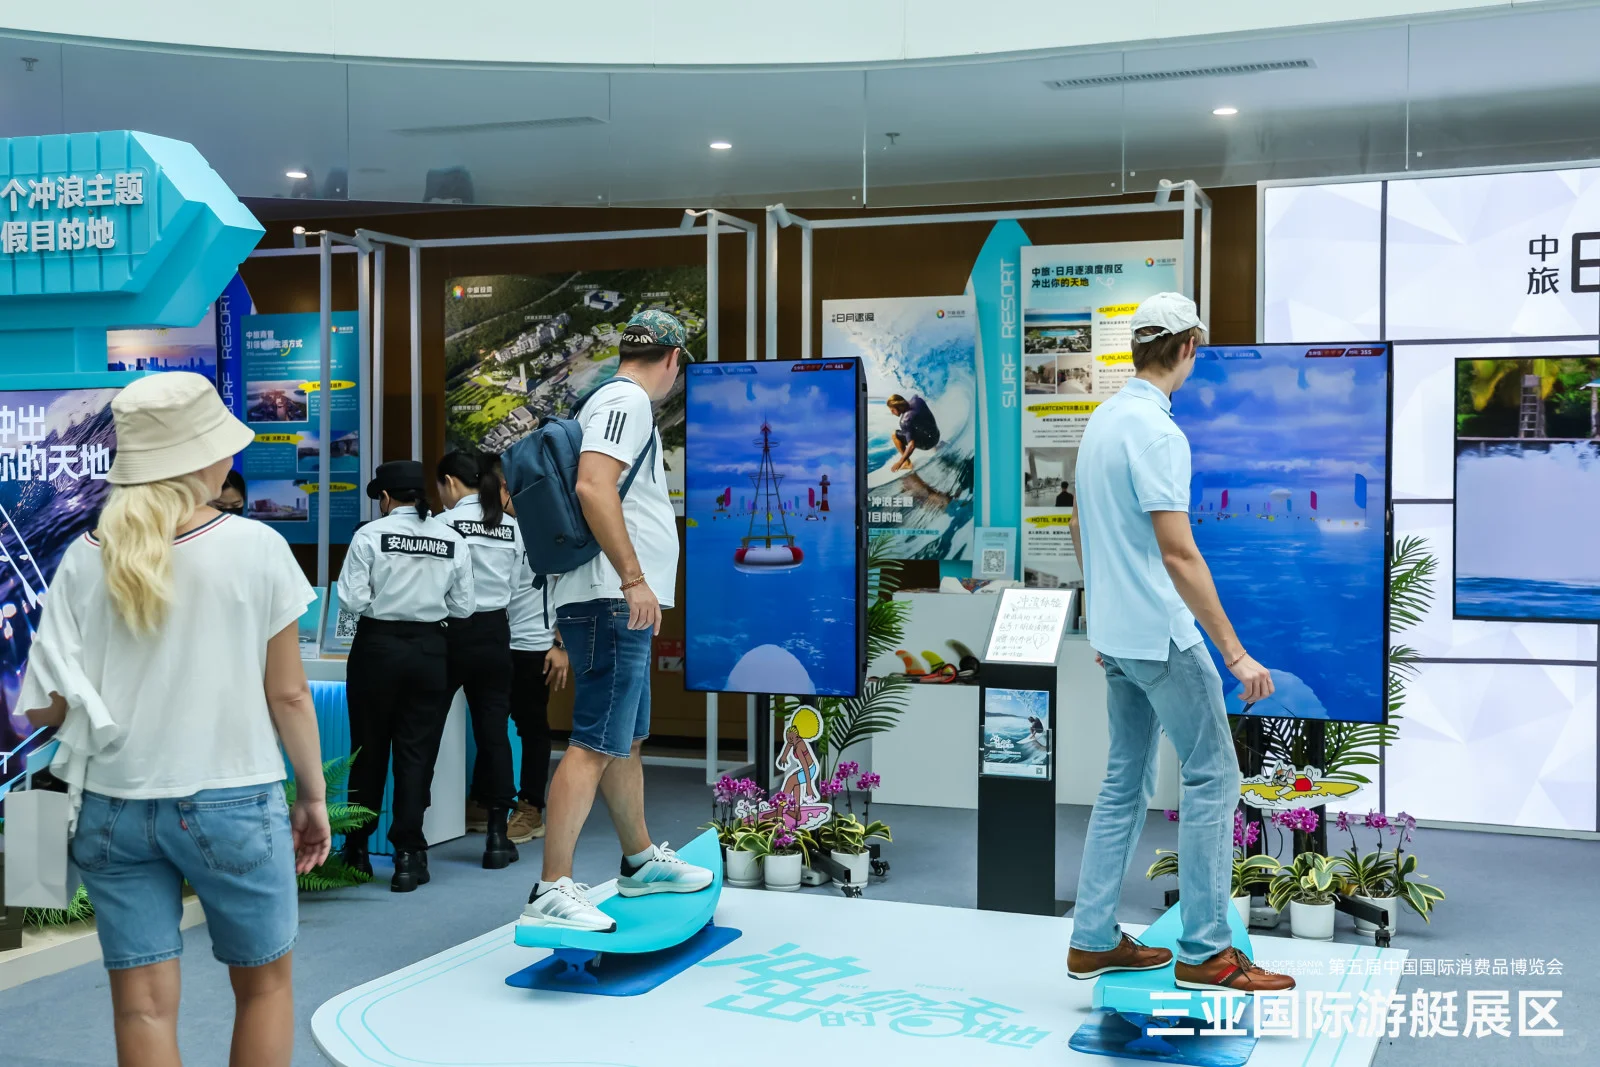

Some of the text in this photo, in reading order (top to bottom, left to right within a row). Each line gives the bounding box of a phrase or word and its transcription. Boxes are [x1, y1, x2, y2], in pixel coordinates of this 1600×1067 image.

[0, 173, 144, 212] 个冲浪主题
[0, 216, 116, 254] 假目的地
[1031, 277, 1090, 289] 冲出你的天地
[1000, 258, 1017, 408] SURF RESORT
[867, 496, 914, 508] 冲浪主题
[867, 511, 903, 523] 目的地
[387, 535, 448, 556] 安ANJIAN检
